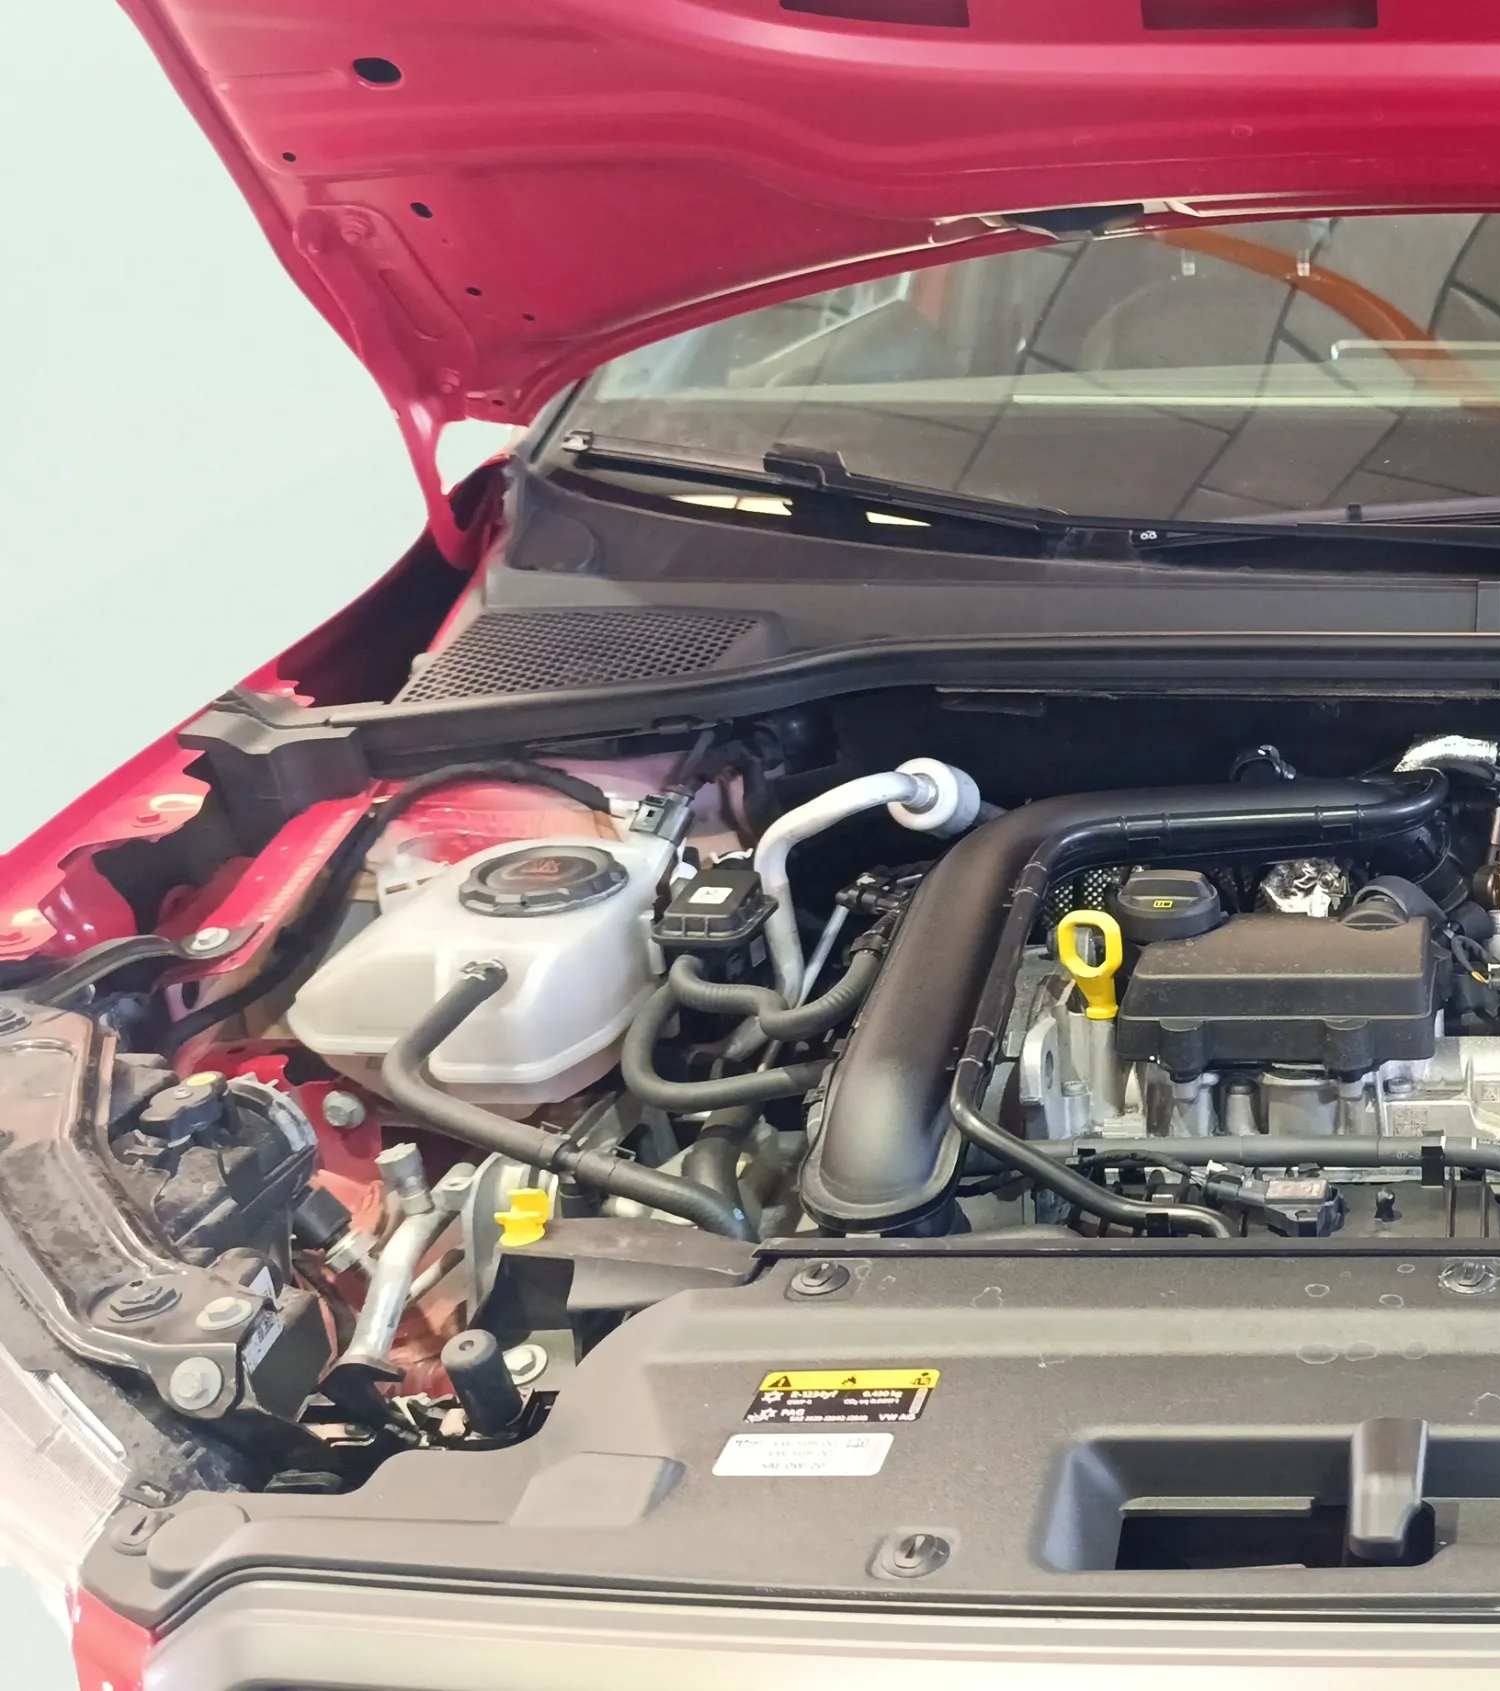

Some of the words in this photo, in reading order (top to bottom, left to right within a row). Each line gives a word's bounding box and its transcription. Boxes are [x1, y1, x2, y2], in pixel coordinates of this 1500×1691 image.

[780, 1408, 806, 1416] PAG
[879, 1413, 898, 1421] VW
[898, 1413, 916, 1421] AG
